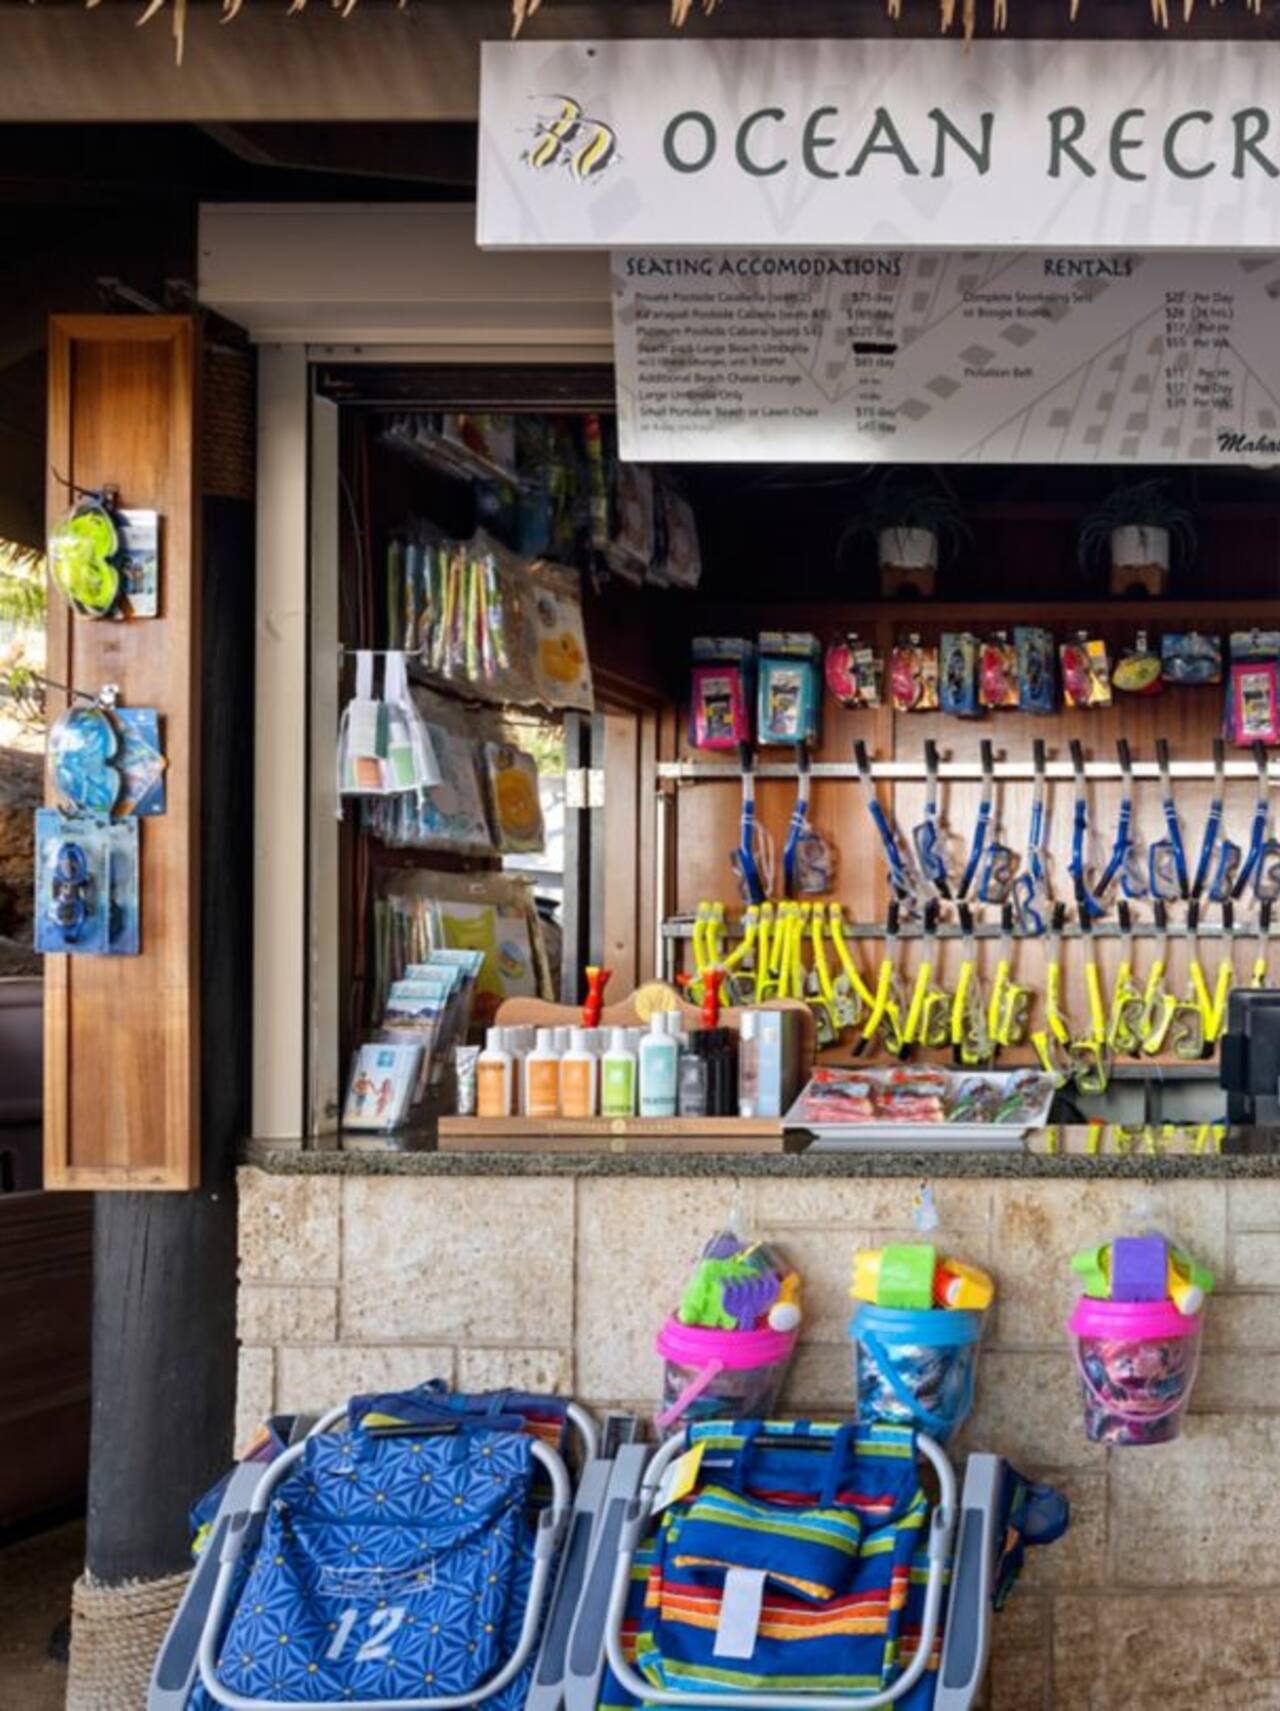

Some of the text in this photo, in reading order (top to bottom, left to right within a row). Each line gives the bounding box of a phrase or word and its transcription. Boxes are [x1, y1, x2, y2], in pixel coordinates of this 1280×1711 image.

[663, 106, 994, 179] OCEAN
[626, 257, 901, 276] SEATING ACCOMODATIONS
[1044, 258, 1134, 277] RENTALS
[325, 1607, 407, 1662] 12
